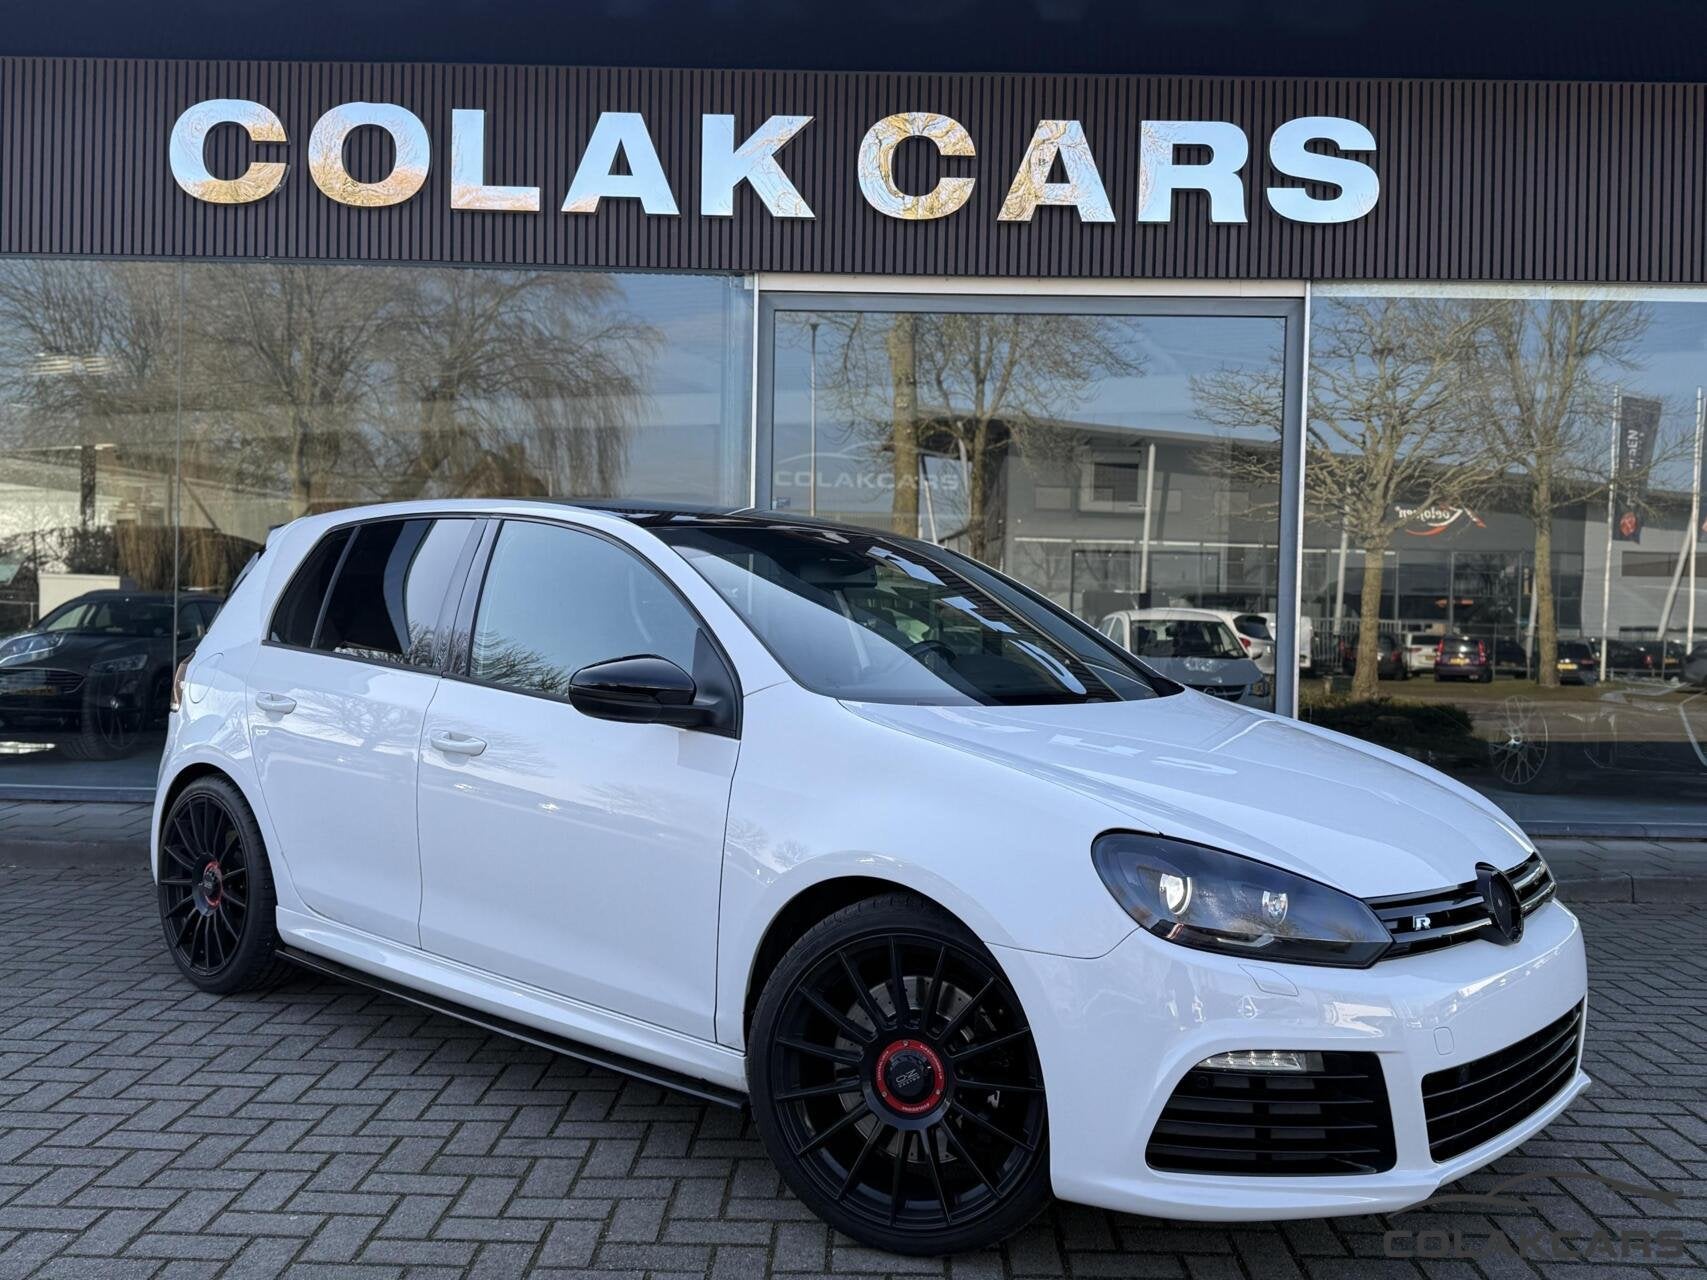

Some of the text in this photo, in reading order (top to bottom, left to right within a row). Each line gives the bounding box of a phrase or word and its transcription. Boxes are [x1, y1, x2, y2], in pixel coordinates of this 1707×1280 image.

[169, 98, 1380, 225] COLAK CARS
[774, 470, 959, 491] COLAKCARS
[1413, 915, 1432, 931] R
